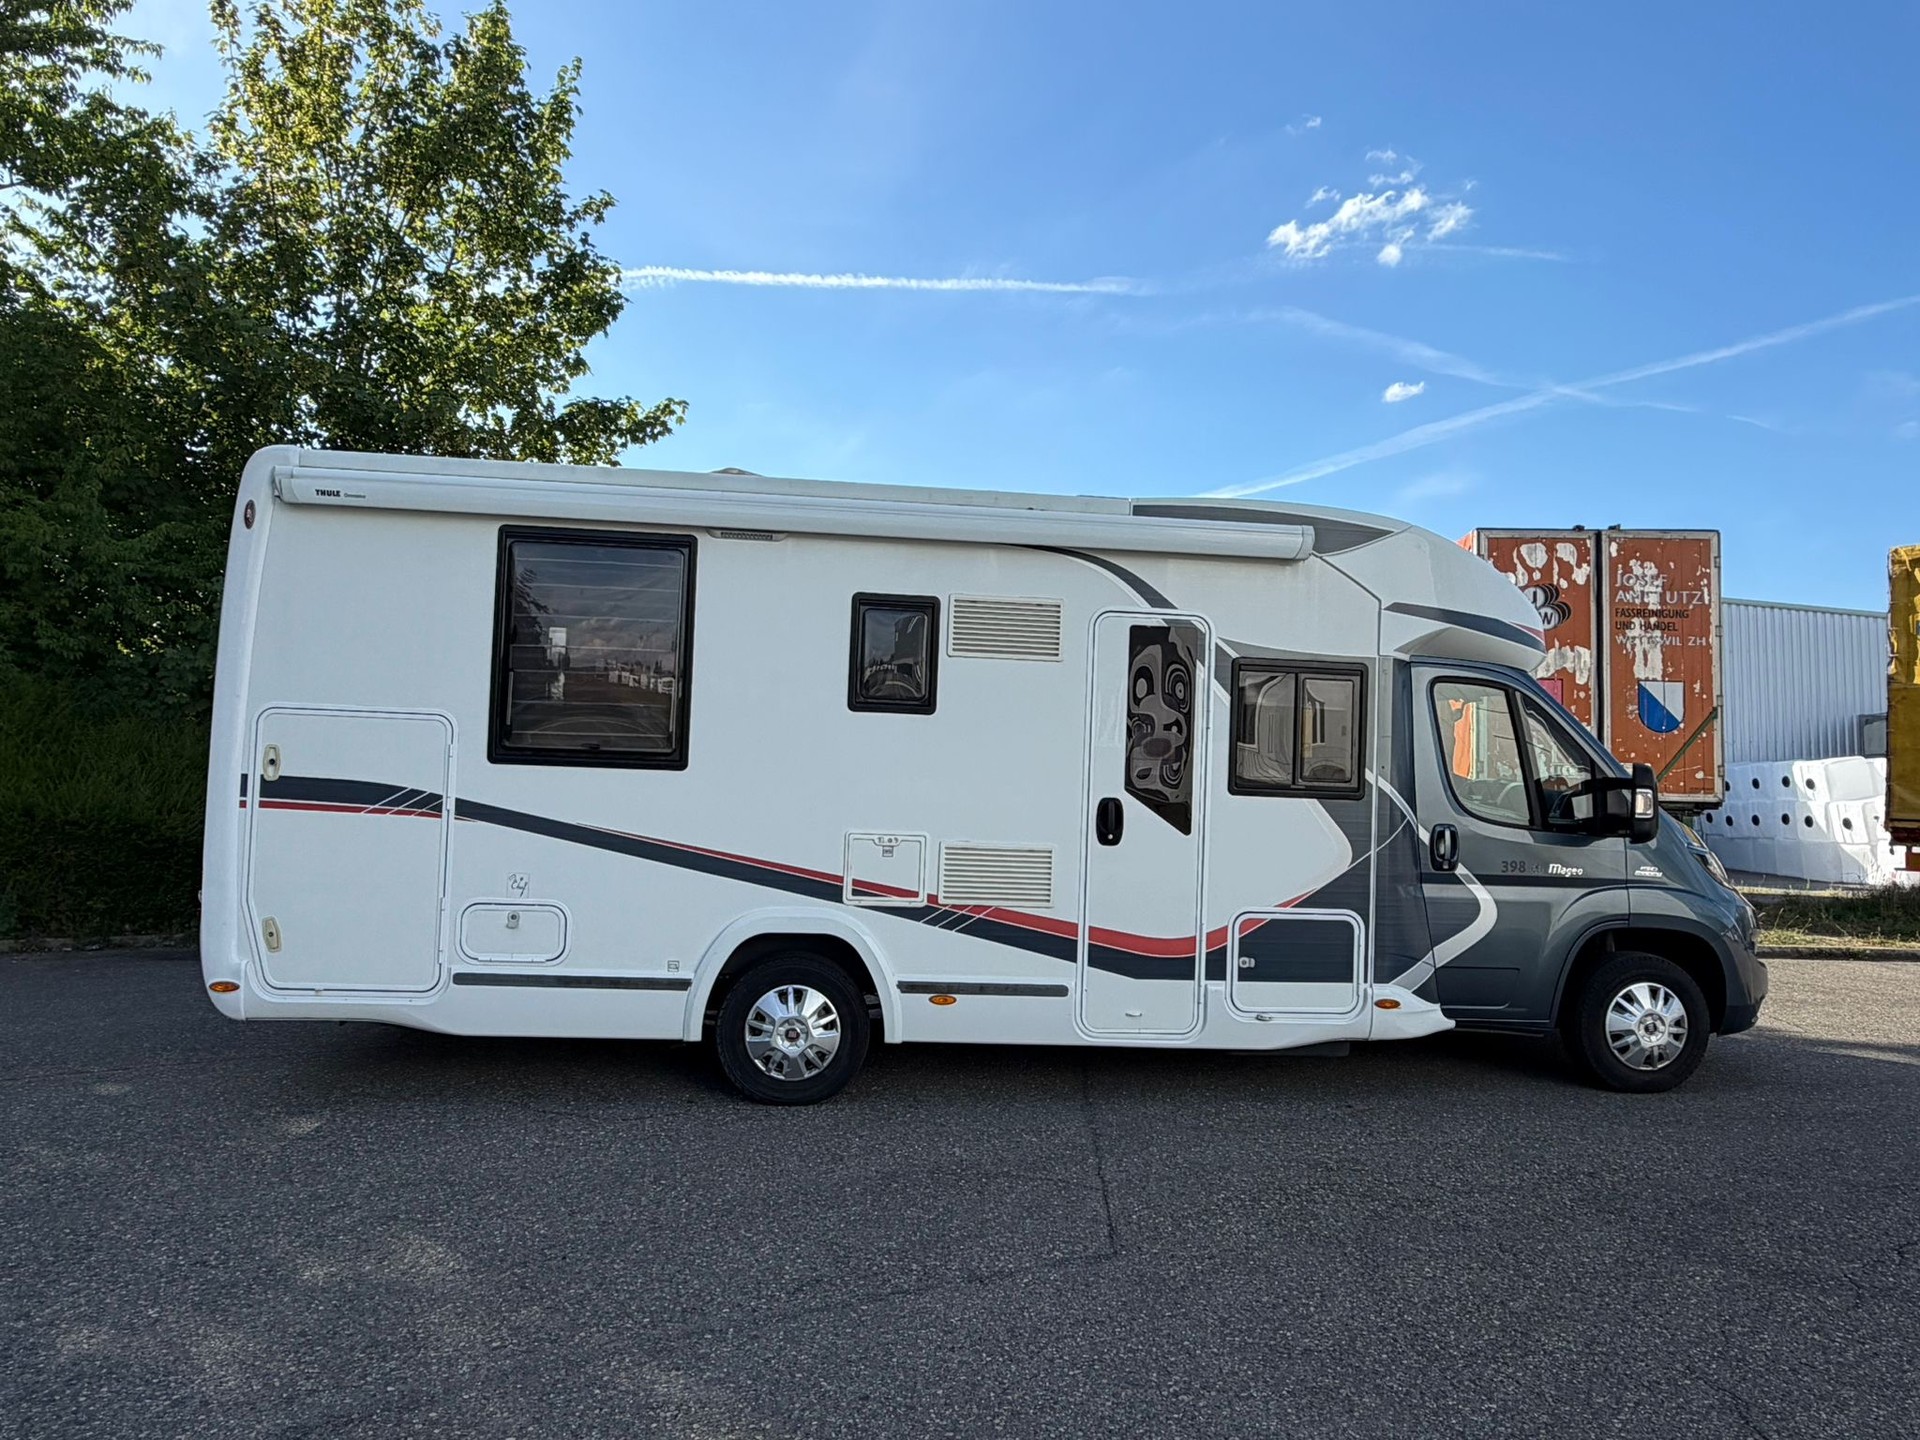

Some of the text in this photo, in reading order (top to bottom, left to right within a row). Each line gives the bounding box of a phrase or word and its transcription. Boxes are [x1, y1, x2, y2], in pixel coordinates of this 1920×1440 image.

[315, 488, 341, 498] THULE
[1615, 571, 1668, 588] JOSEF
[1614, 589, 1703, 605] AMUTZ
[1614, 607, 1690, 620] FASSREINIGUNG
[1614, 620, 1679, 632] UND HANDEL
[1687, 635, 1707, 647] ZH
[1501, 860, 1527, 874] 398
[1548, 863, 1584, 878] Mageo
